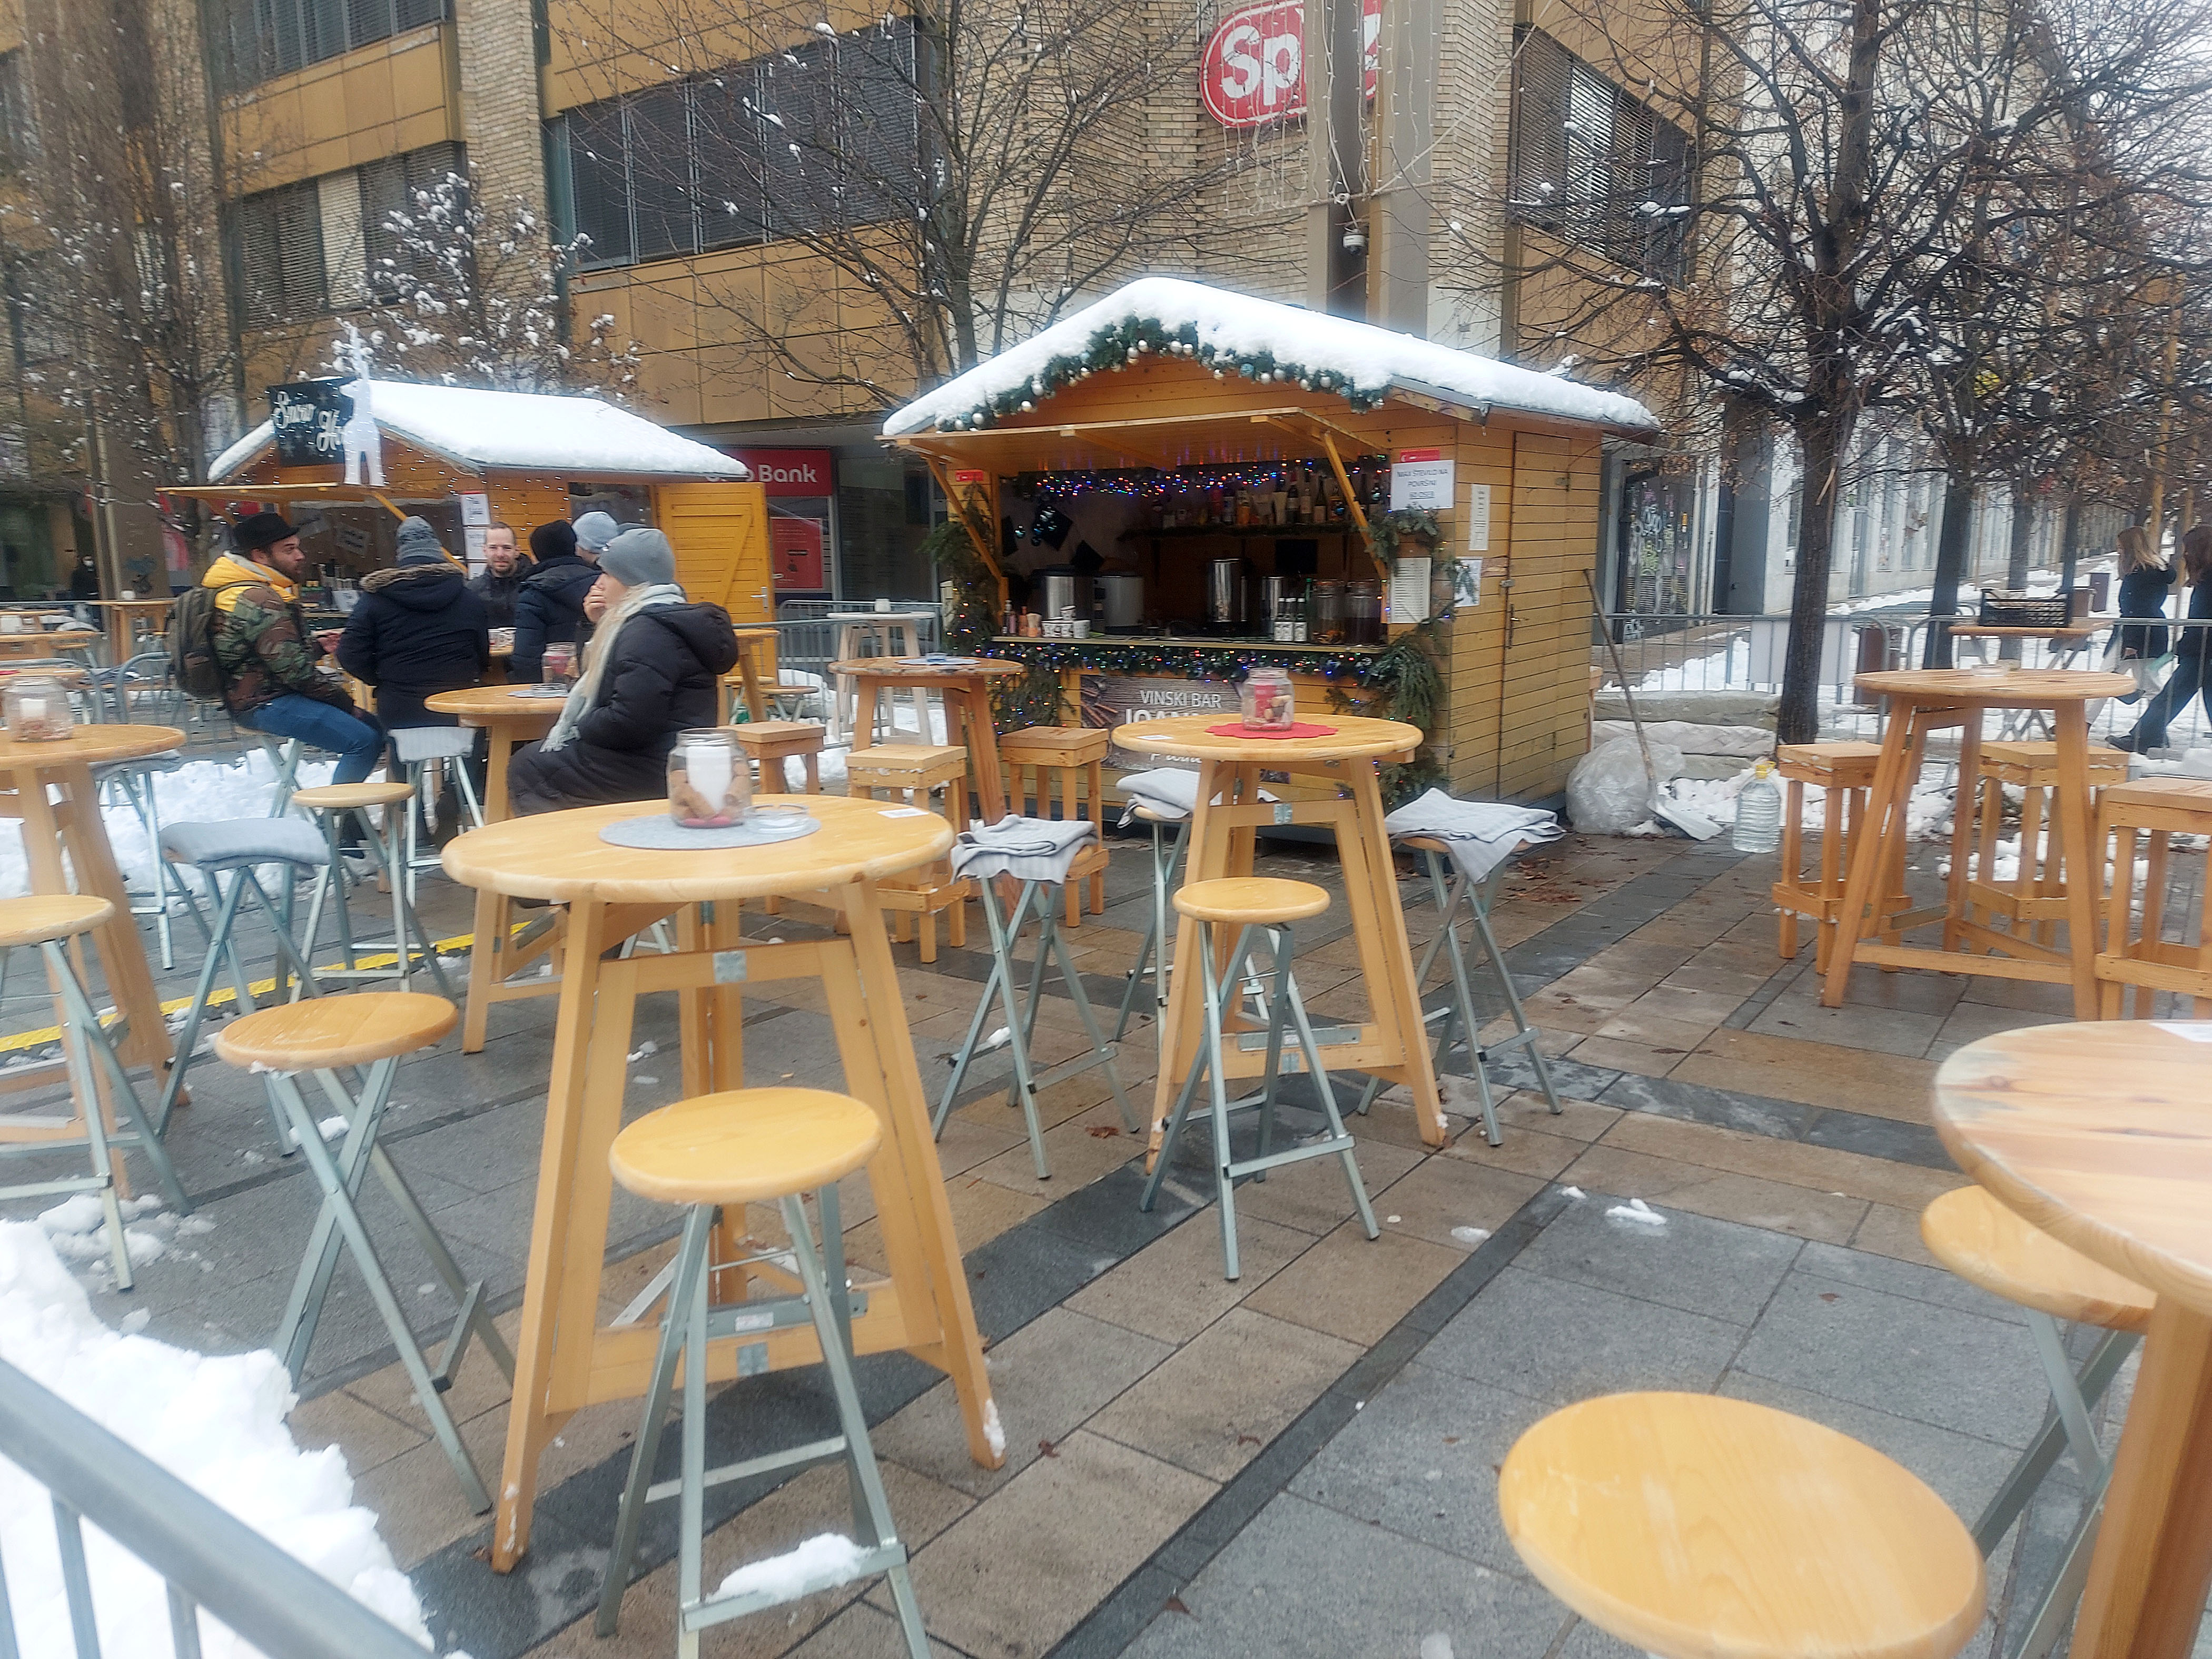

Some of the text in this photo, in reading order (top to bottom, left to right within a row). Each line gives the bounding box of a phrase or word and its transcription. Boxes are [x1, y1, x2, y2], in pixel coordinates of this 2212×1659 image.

[757, 463, 817, 482] Bank
[1140, 690, 1222, 708] VINSKI BAR
